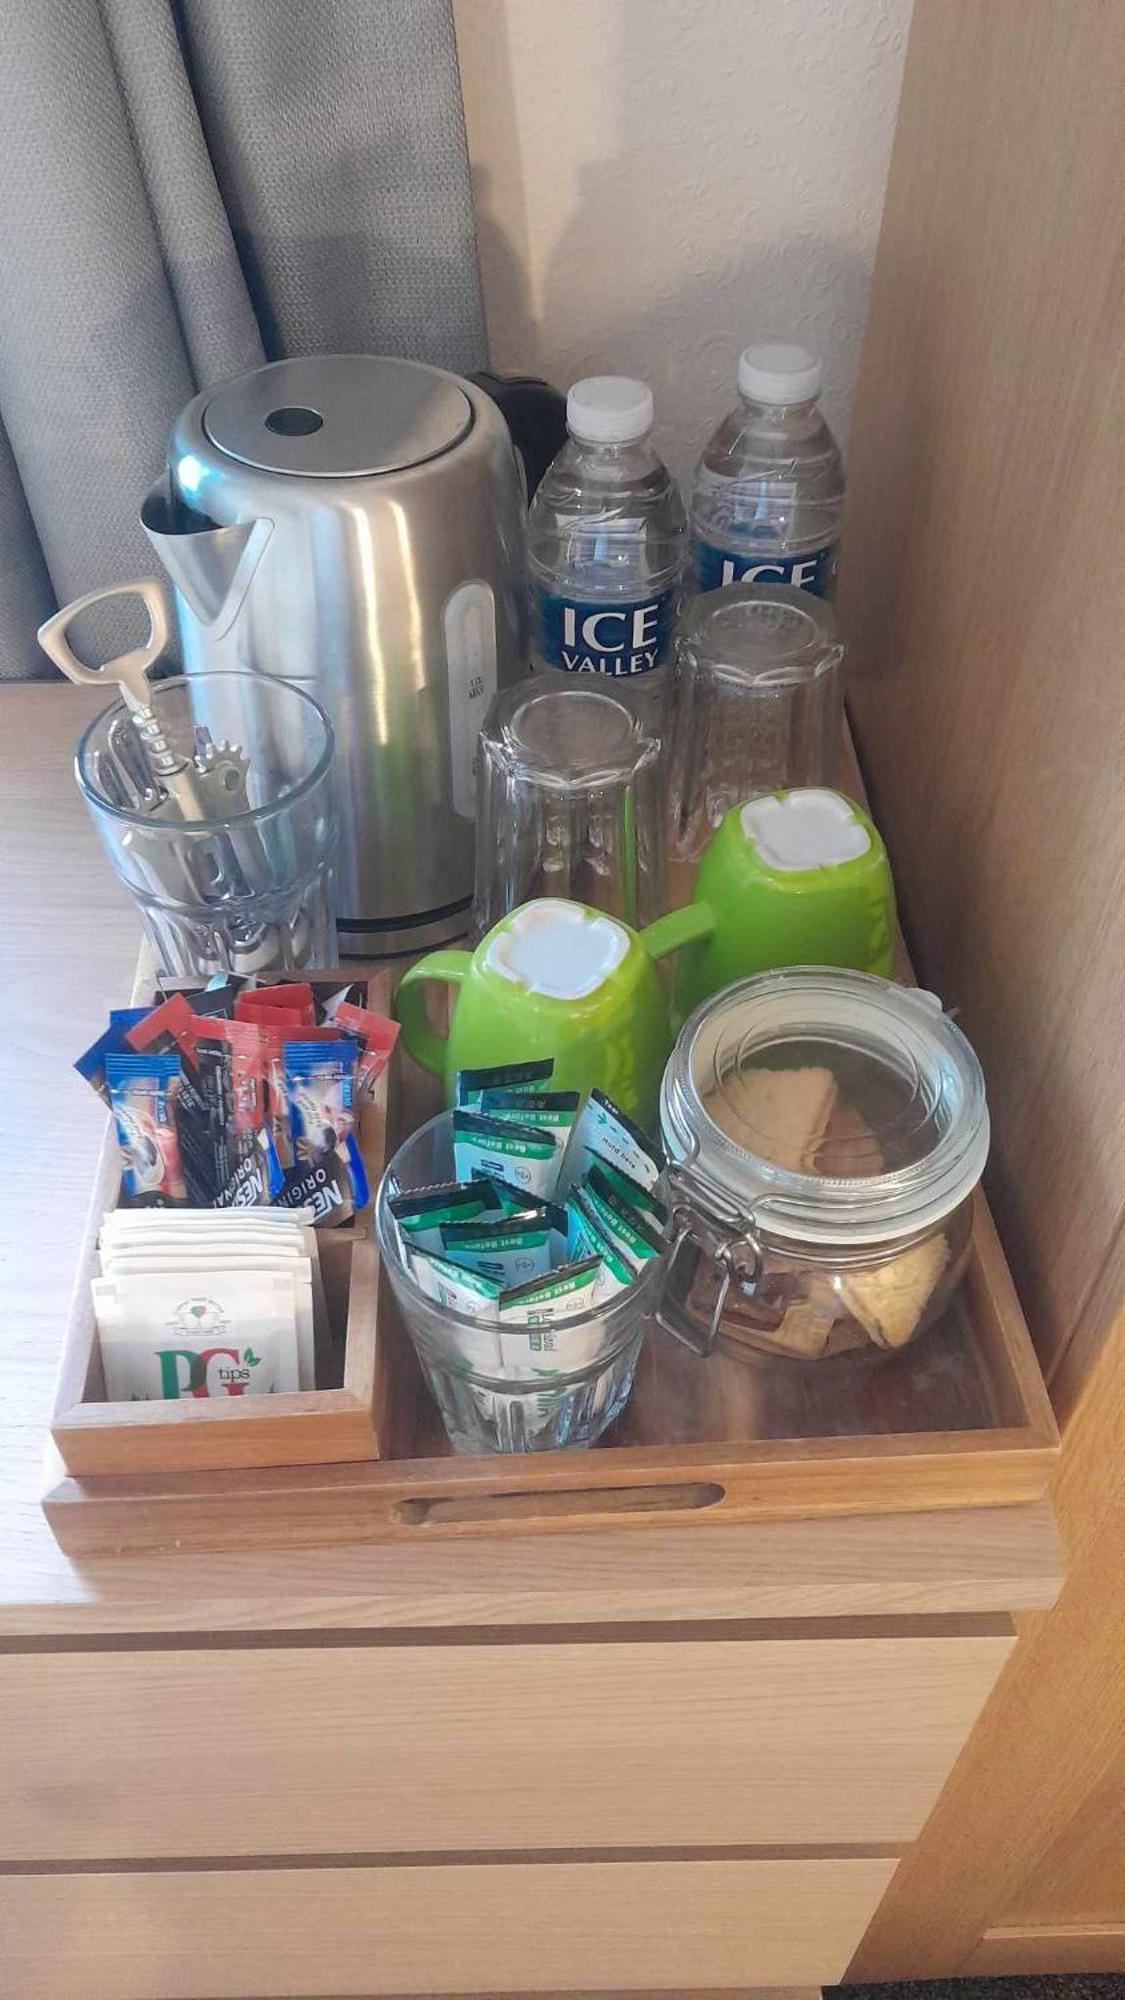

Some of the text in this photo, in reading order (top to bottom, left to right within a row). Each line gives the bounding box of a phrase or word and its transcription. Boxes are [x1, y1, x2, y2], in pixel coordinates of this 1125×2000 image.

[563, 604, 659, 652] ICE
[561, 649, 658, 678] VALLEY
[153, 1347, 250, 1399] PG tips
